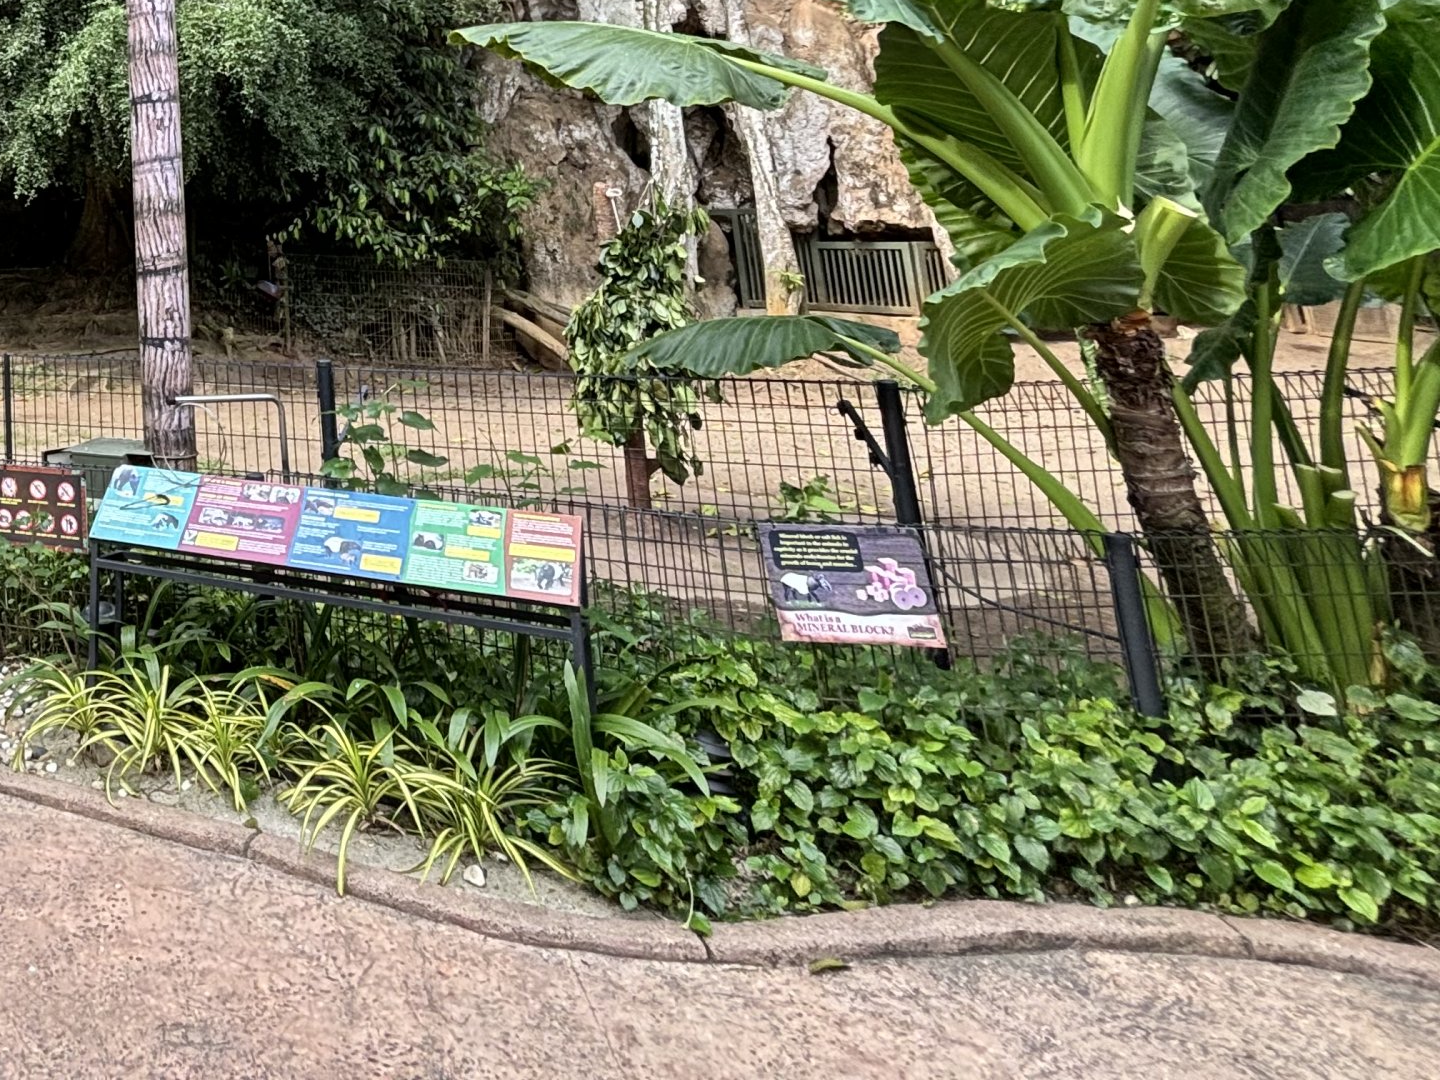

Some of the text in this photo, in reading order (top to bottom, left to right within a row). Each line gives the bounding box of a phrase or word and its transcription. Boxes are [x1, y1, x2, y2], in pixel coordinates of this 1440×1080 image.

[795, 613, 822, 623] What
[825, 614, 834, 623] is
[797, 622, 895, 635] MINERAL BLOCK?
